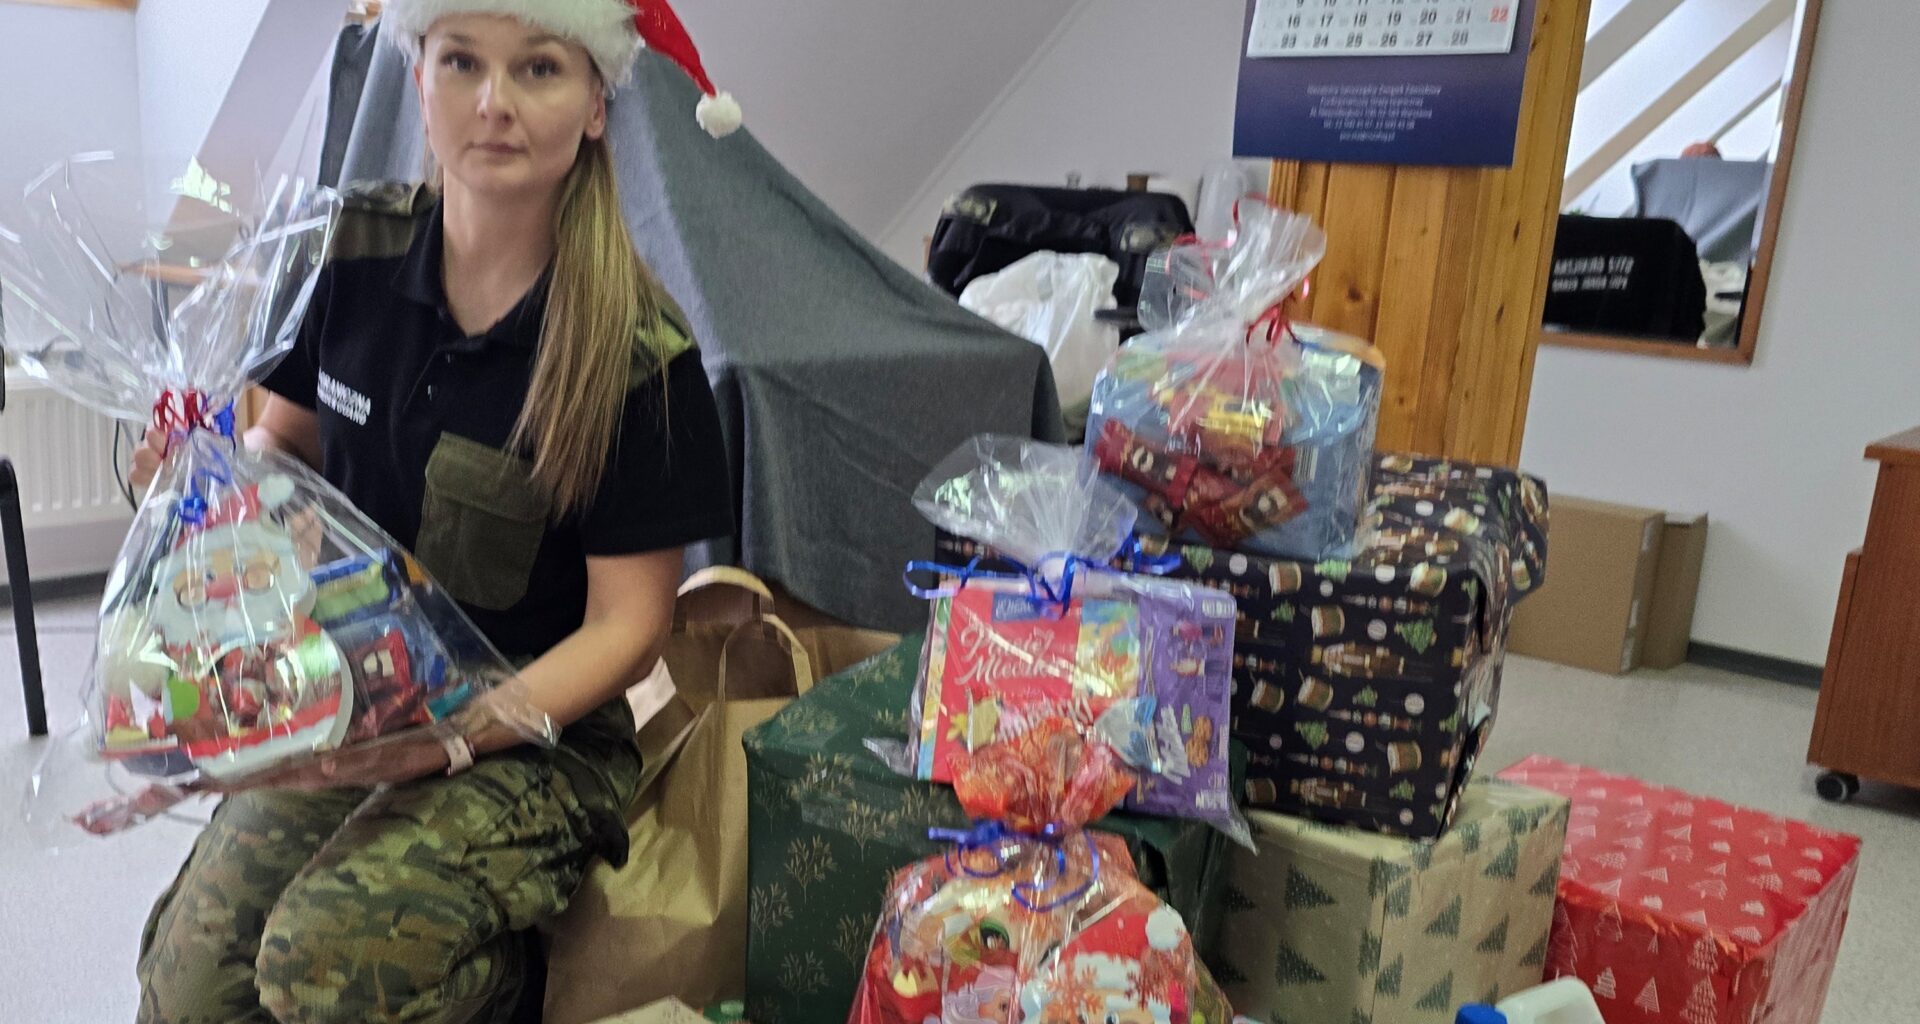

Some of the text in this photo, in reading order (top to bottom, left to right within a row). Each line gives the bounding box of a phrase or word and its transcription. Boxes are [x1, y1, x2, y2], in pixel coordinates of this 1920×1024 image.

[1288, 5, 1509, 28] 16 17 18 19 20 21 22
[1281, 29, 1469, 49] 23 24 25 26 27 28
